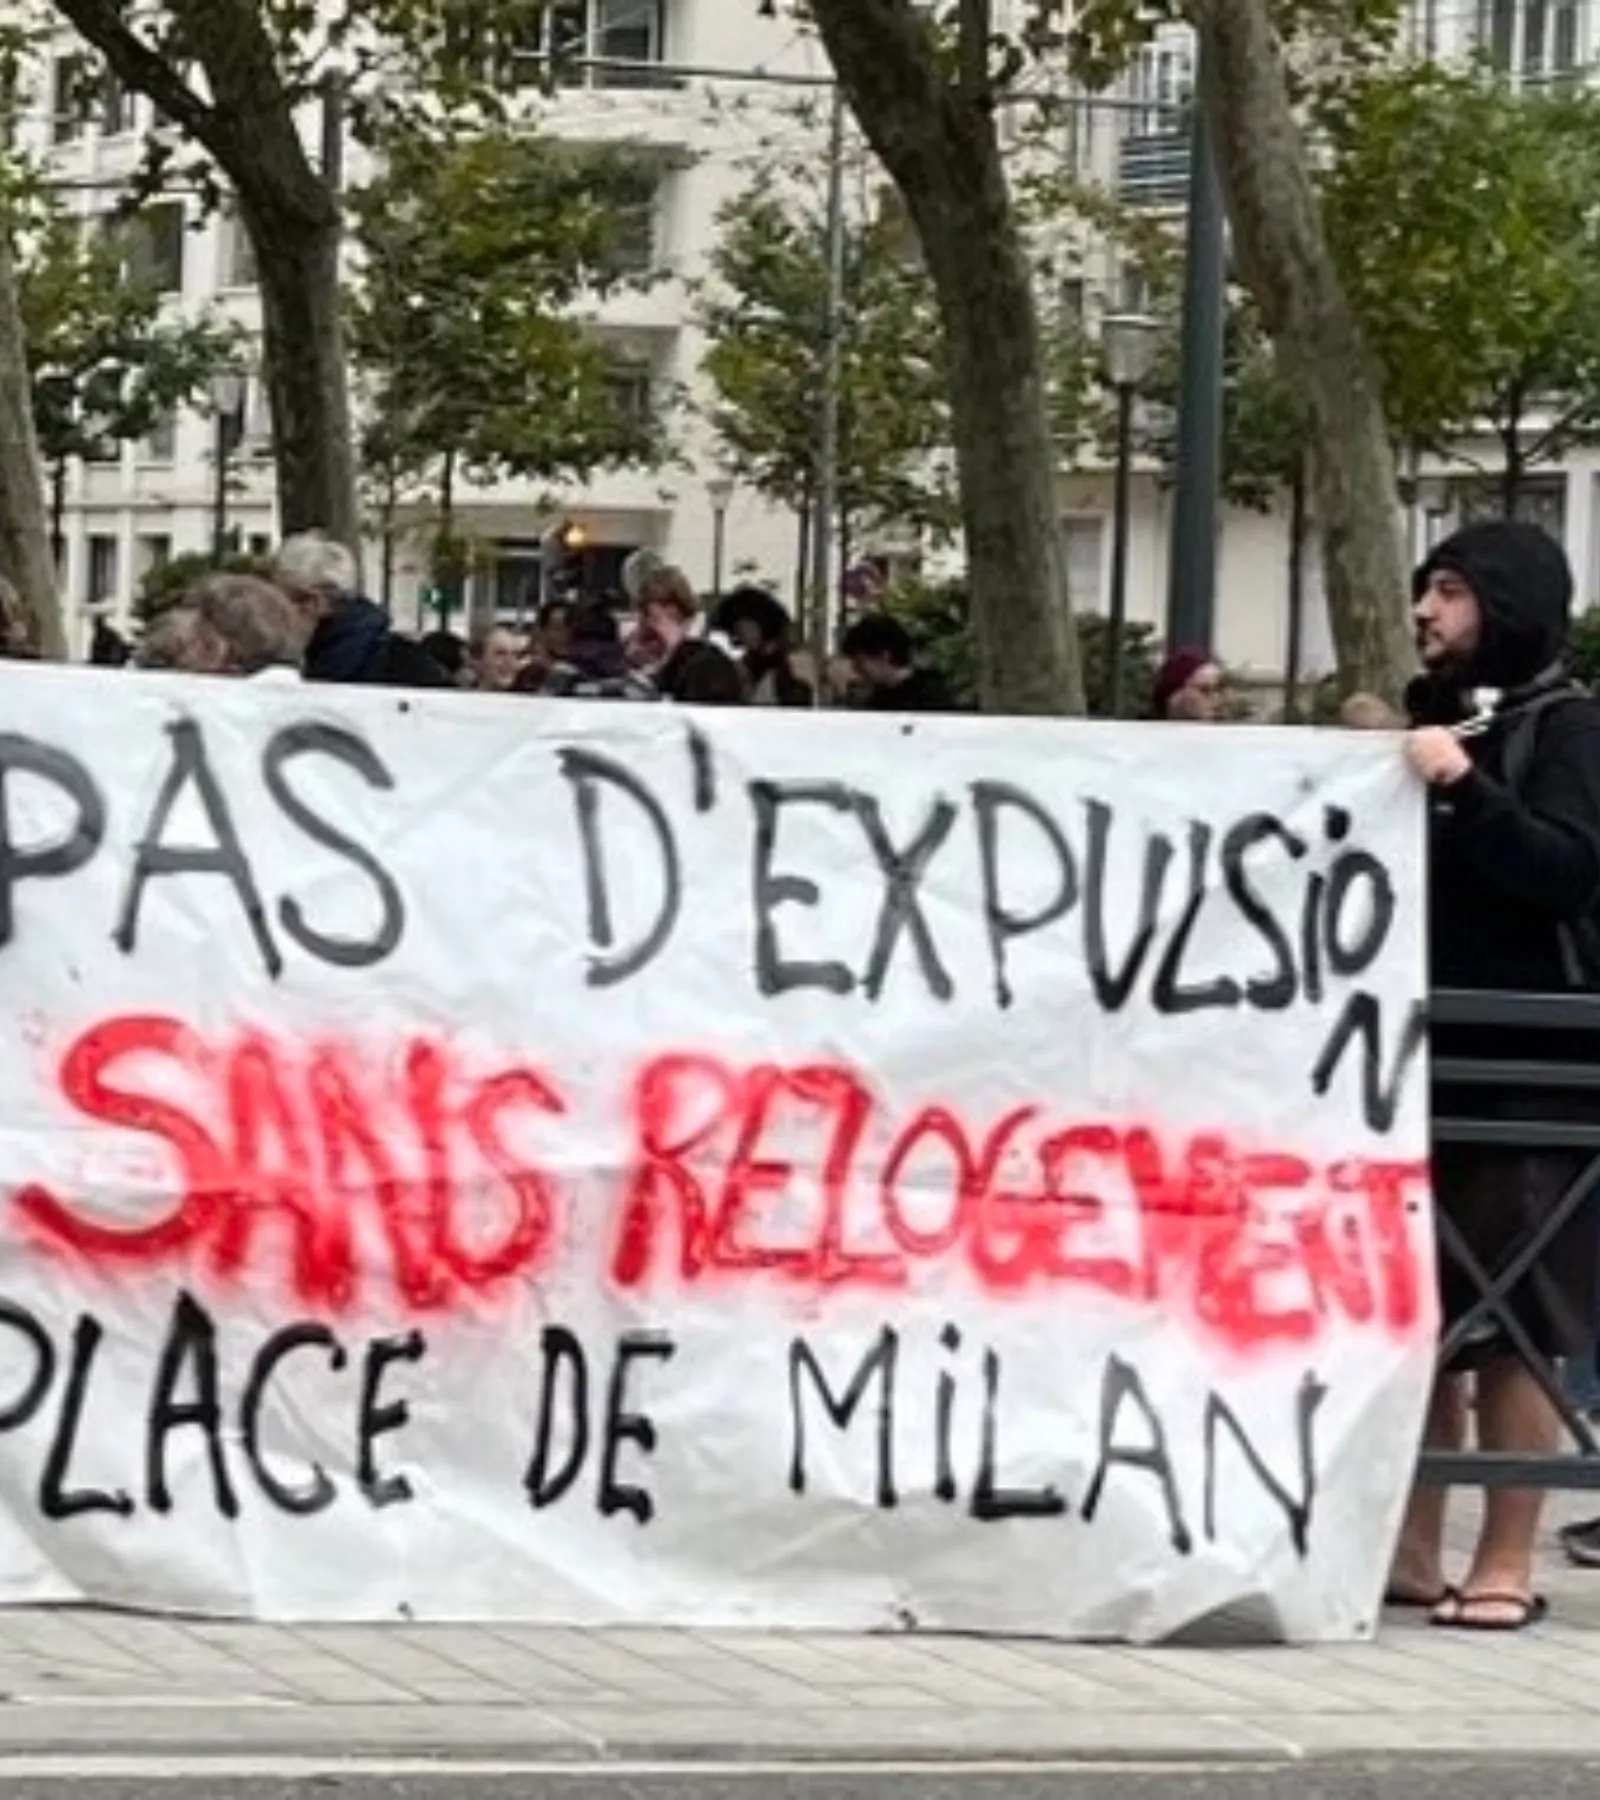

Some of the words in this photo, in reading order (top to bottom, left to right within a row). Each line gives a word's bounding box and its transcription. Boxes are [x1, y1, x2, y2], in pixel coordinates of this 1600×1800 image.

[10, 1012, 568, 1312] SANS
[612, 1046, 1428, 1350] RELOGEMENT
[522, 1324, 676, 1526] DE
